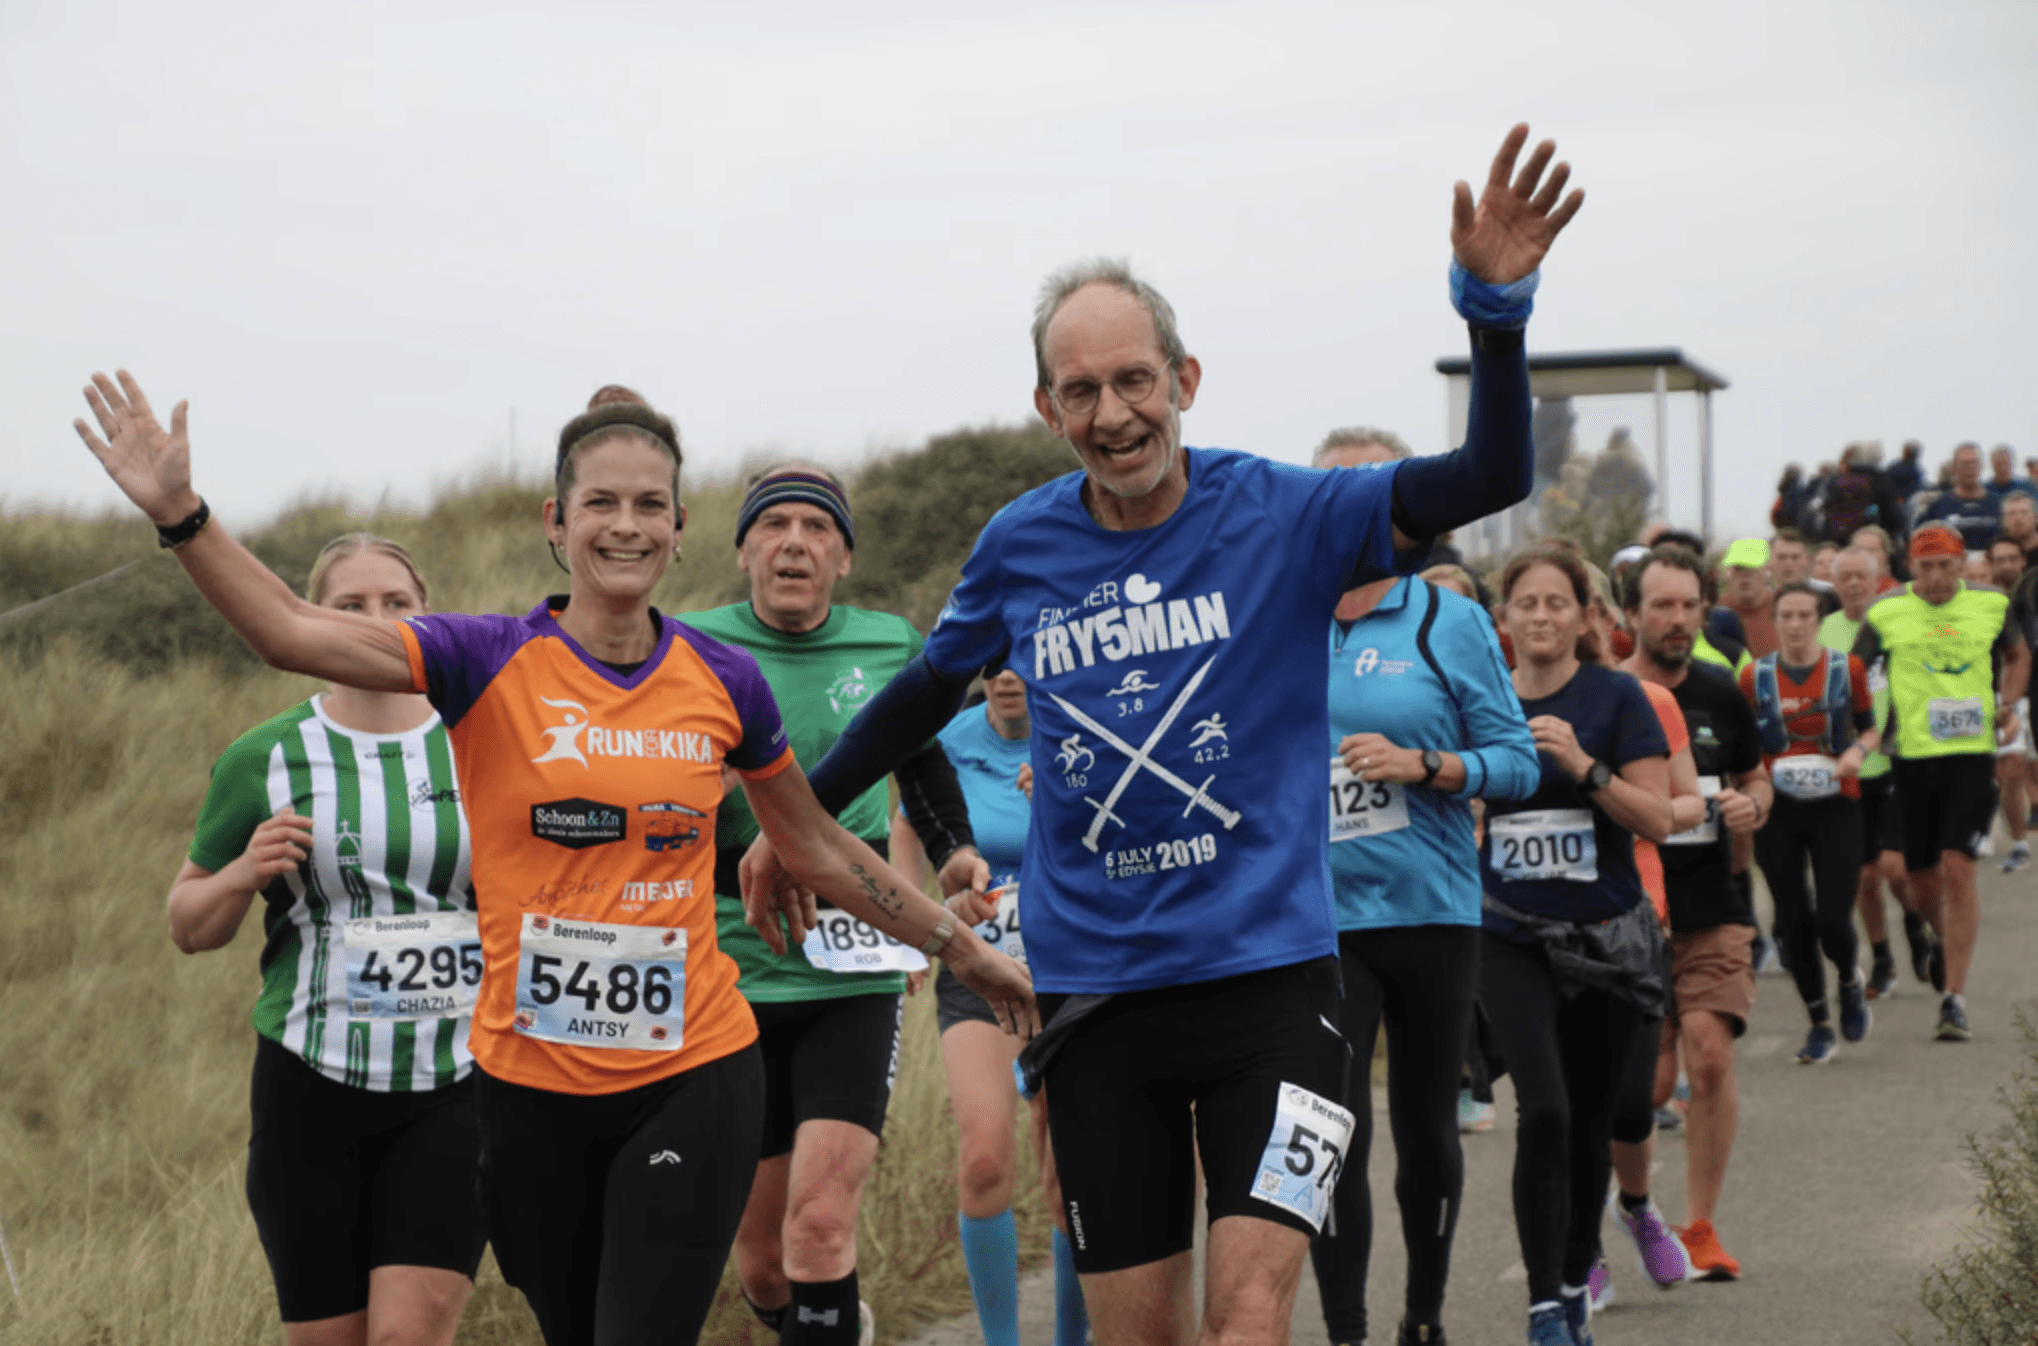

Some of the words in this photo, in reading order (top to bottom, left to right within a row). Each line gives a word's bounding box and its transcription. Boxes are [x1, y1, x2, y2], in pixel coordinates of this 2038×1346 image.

[1033, 591, 1231, 681] FRY5MAN
[1118, 697, 1143, 717] 3.8
[587, 726, 644, 758] RUN
[659, 730, 713, 765] KIKA
[1194, 744, 1230, 764] 42.2
[1065, 773, 1088, 789] 180
[1105, 851, 1115, 867] 6
[1117, 846, 1153, 866] JULY
[1156, 833, 1217, 871] 2019
[1503, 833, 1582, 869] 2010
[375, 920, 431, 933] Berenloop
[553, 924, 617, 945] Berenloop
[359, 943, 483, 993] 4295
[530, 954, 673, 1015] 5486
[397, 996, 456, 1013] CHAZIA
[567, 1018, 630, 1038] ANTSY
[1069, 1201, 1087, 1250] FUSION
